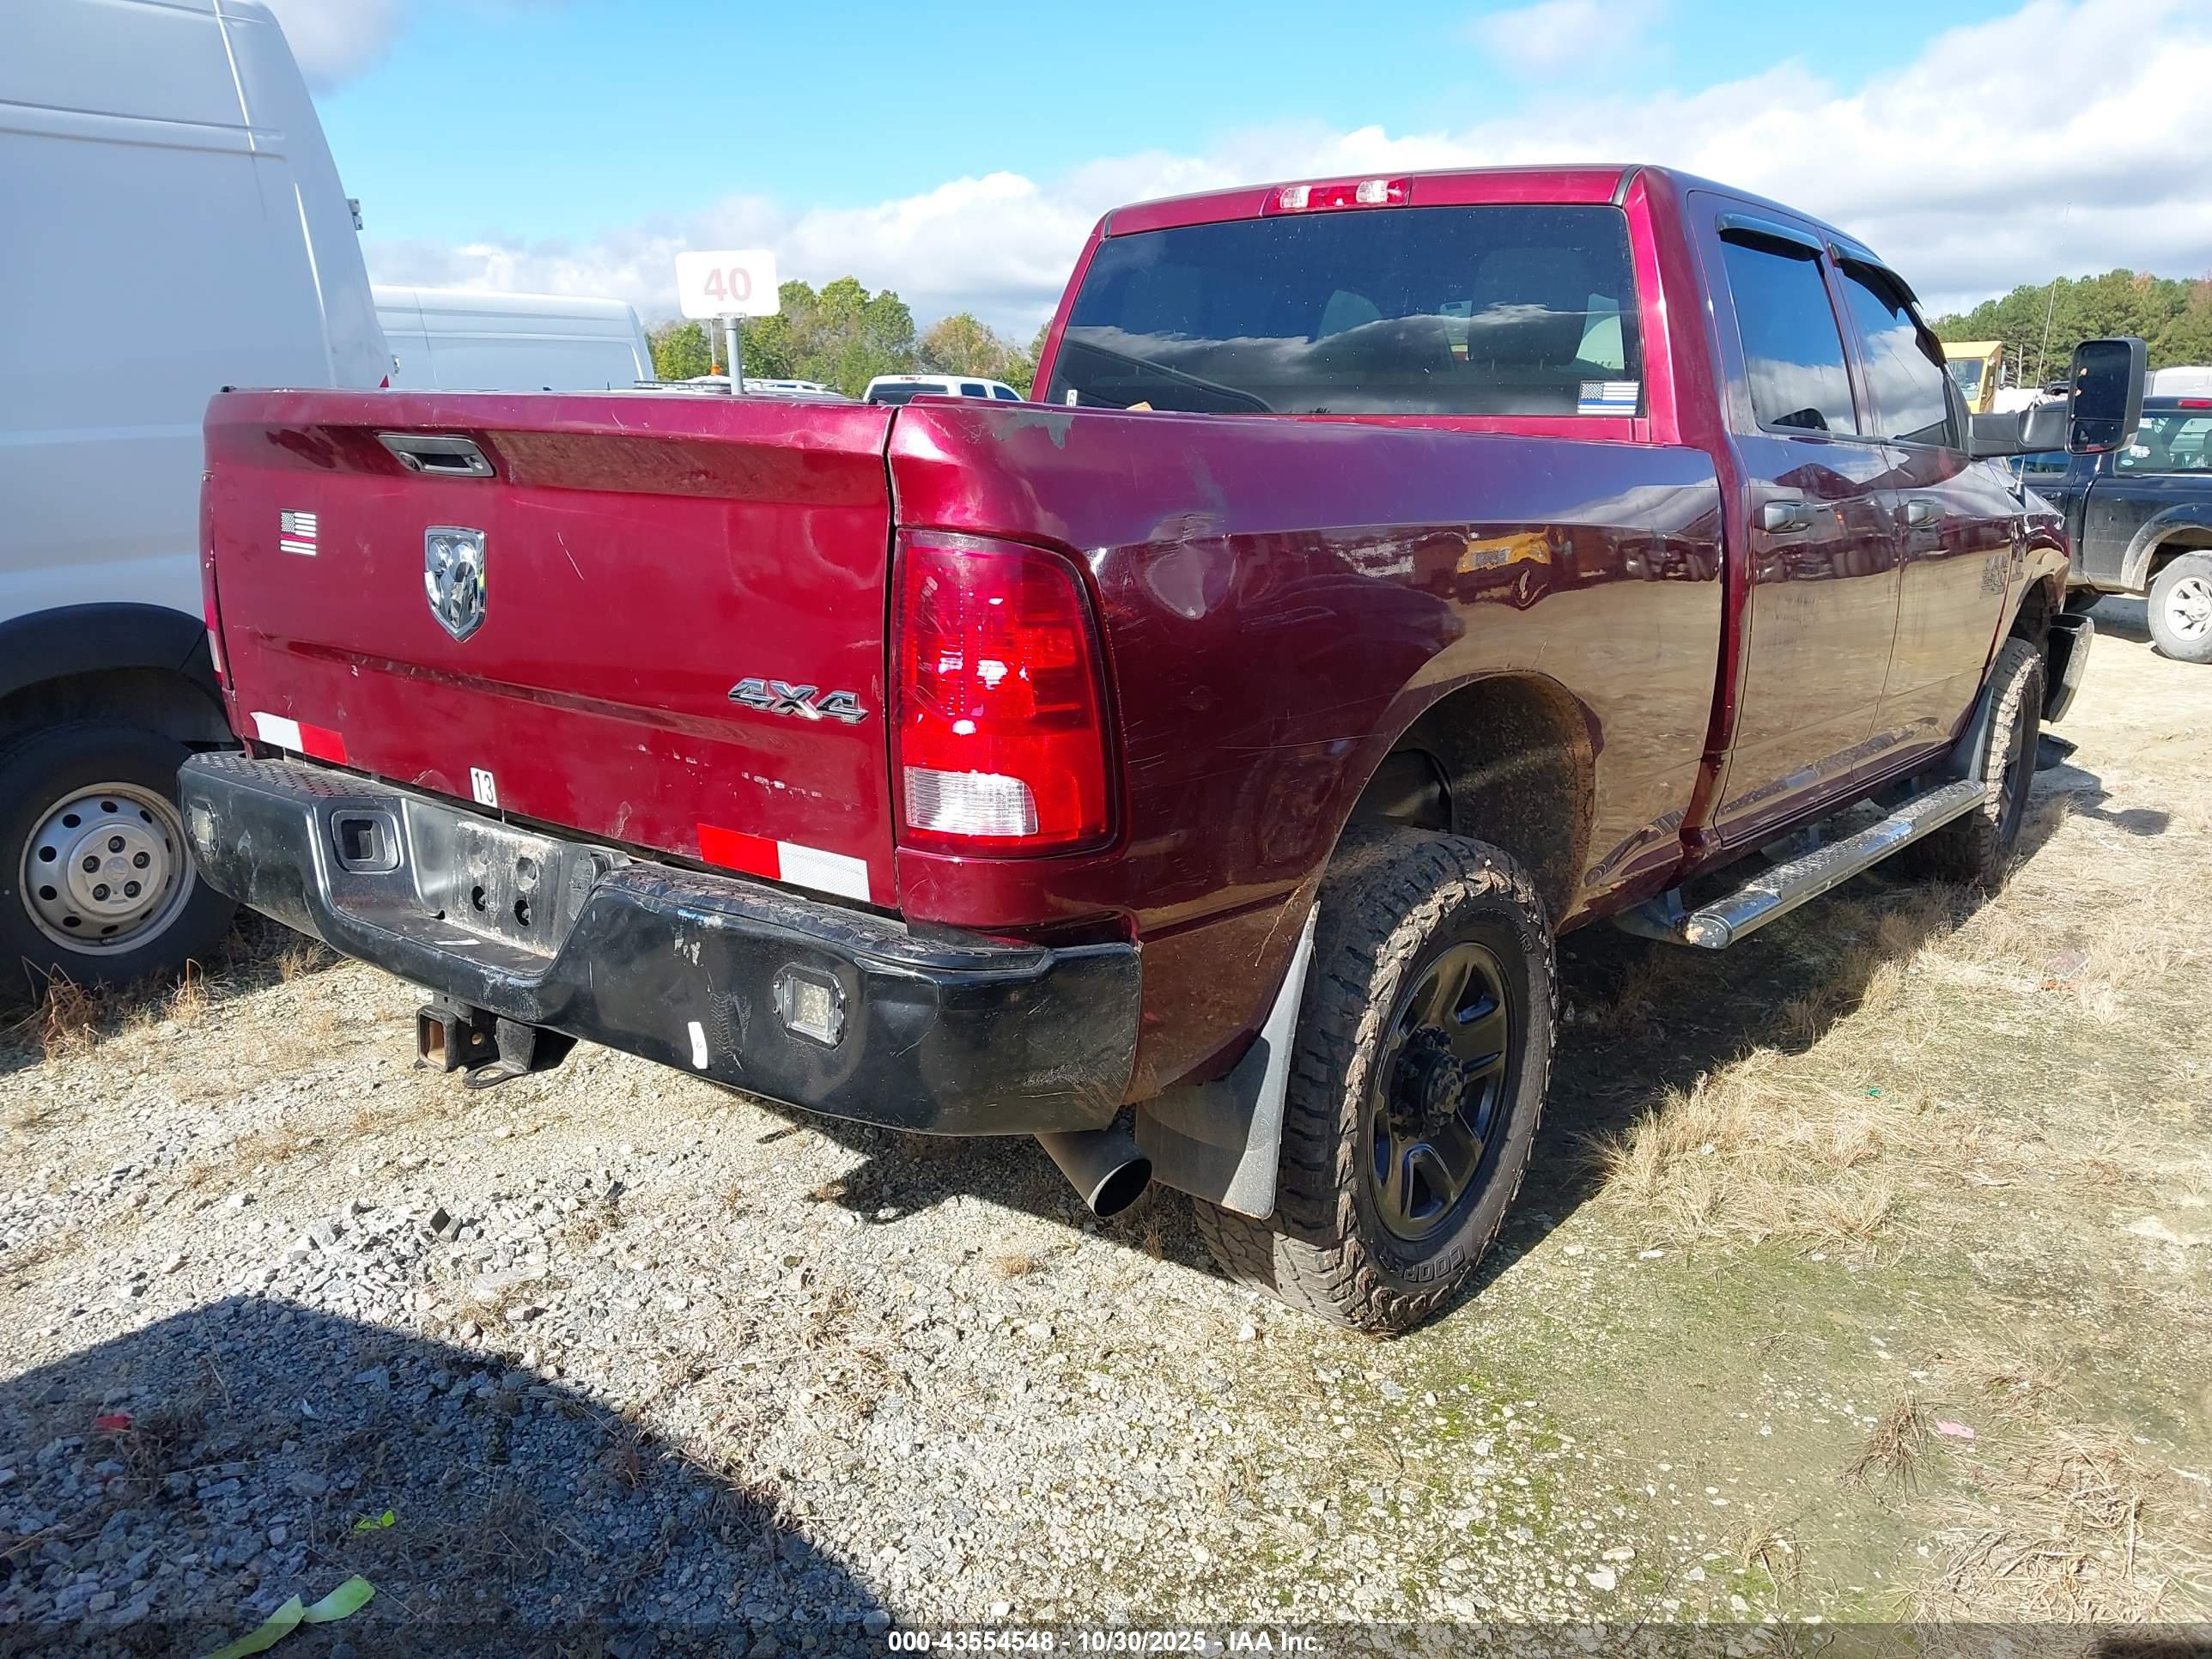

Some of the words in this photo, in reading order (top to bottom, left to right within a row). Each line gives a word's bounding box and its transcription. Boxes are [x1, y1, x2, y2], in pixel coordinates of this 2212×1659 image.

[703, 267, 752, 302] 40
[474, 770, 495, 804] 13
[1378, 1243, 1465, 1283] COOP
